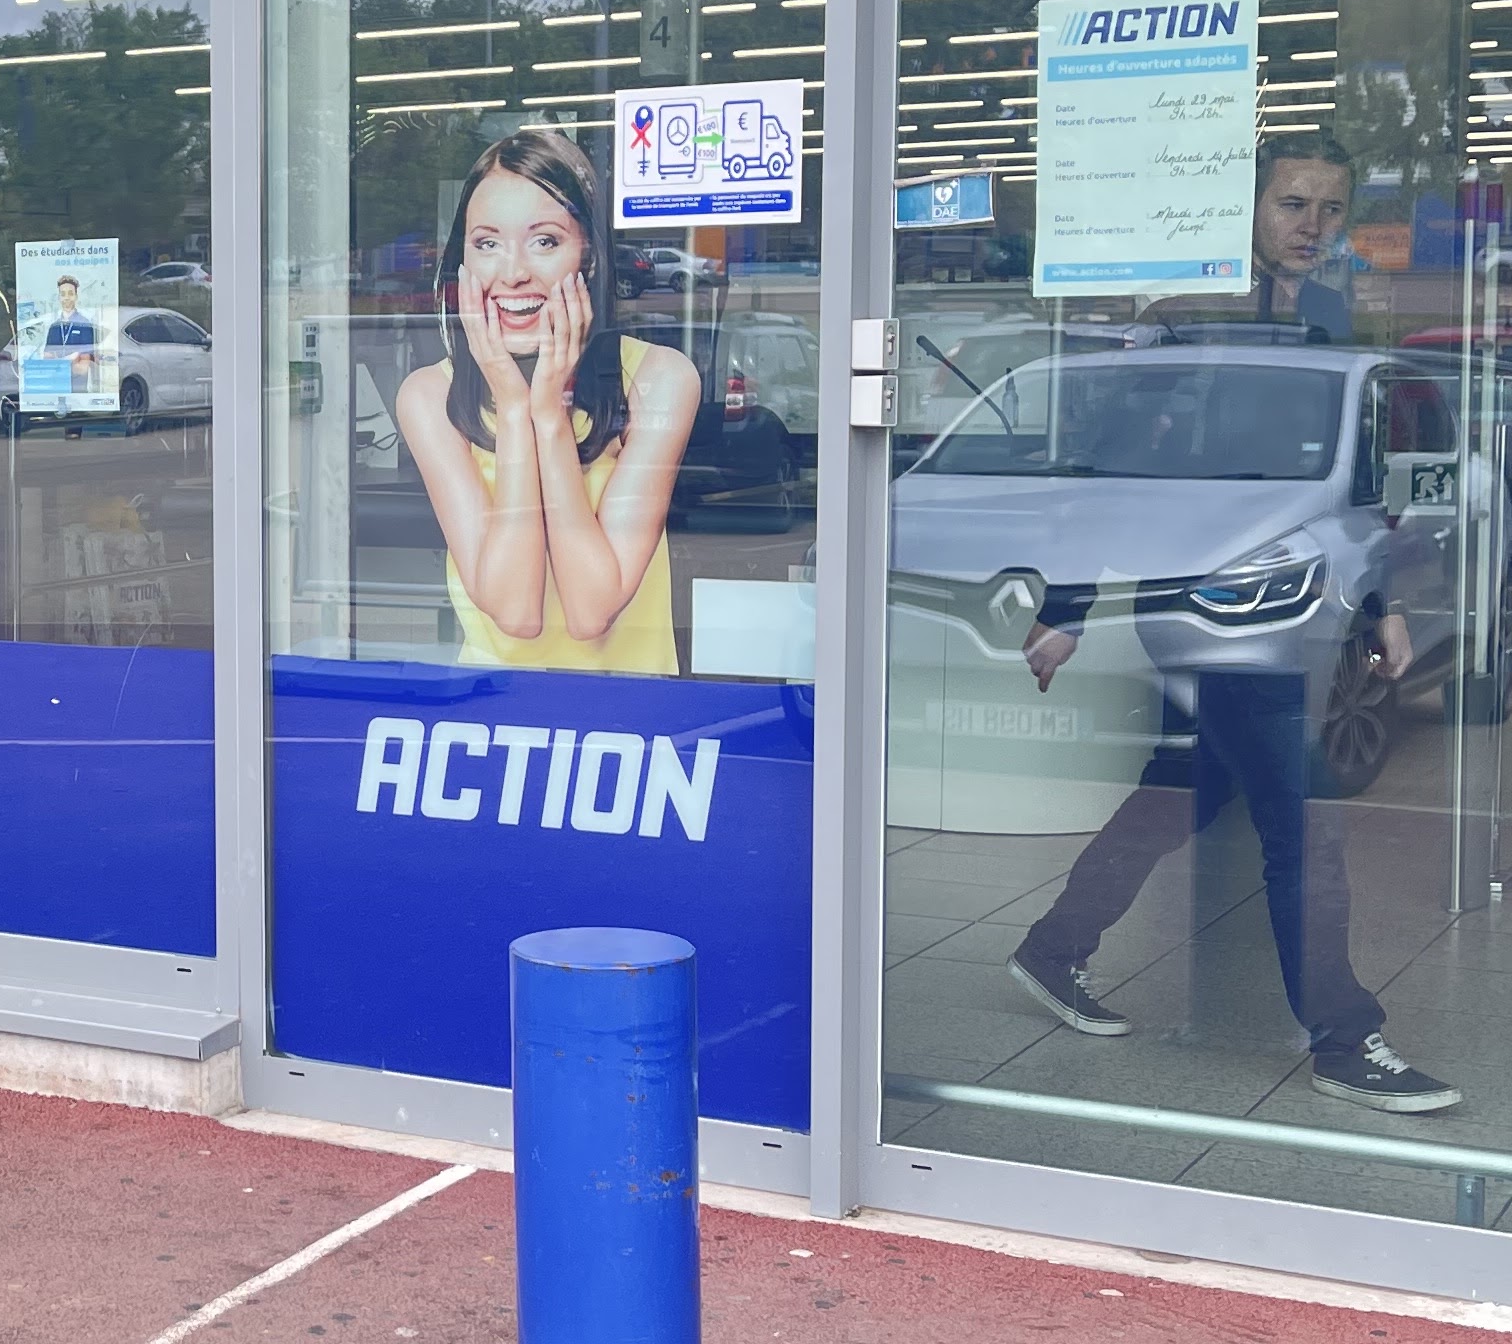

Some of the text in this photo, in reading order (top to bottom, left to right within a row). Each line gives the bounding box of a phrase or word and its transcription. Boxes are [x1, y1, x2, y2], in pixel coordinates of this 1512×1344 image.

[1081, 1, 1240, 45] ACTION
[649, 16, 671, 48] 4
[1058, 53, 1237, 74] Heures d'ouverture adaptés
[1190, 94, 1206, 105] 29
[1055, 105, 1076, 113] Date
[1055, 116, 1136, 127] Heures d'ouverture
[1055, 159, 1075, 167] Date
[1055, 171, 1136, 182] Heures d'ouverture
[933, 206, 958, 218] DAE
[1055, 226, 1135, 236] Heures d'ouverture
[21, 245, 109, 257] Des étudiants dans
[1052, 267, 1134, 277] www.action.com
[356, 716, 721, 841] ACTION
